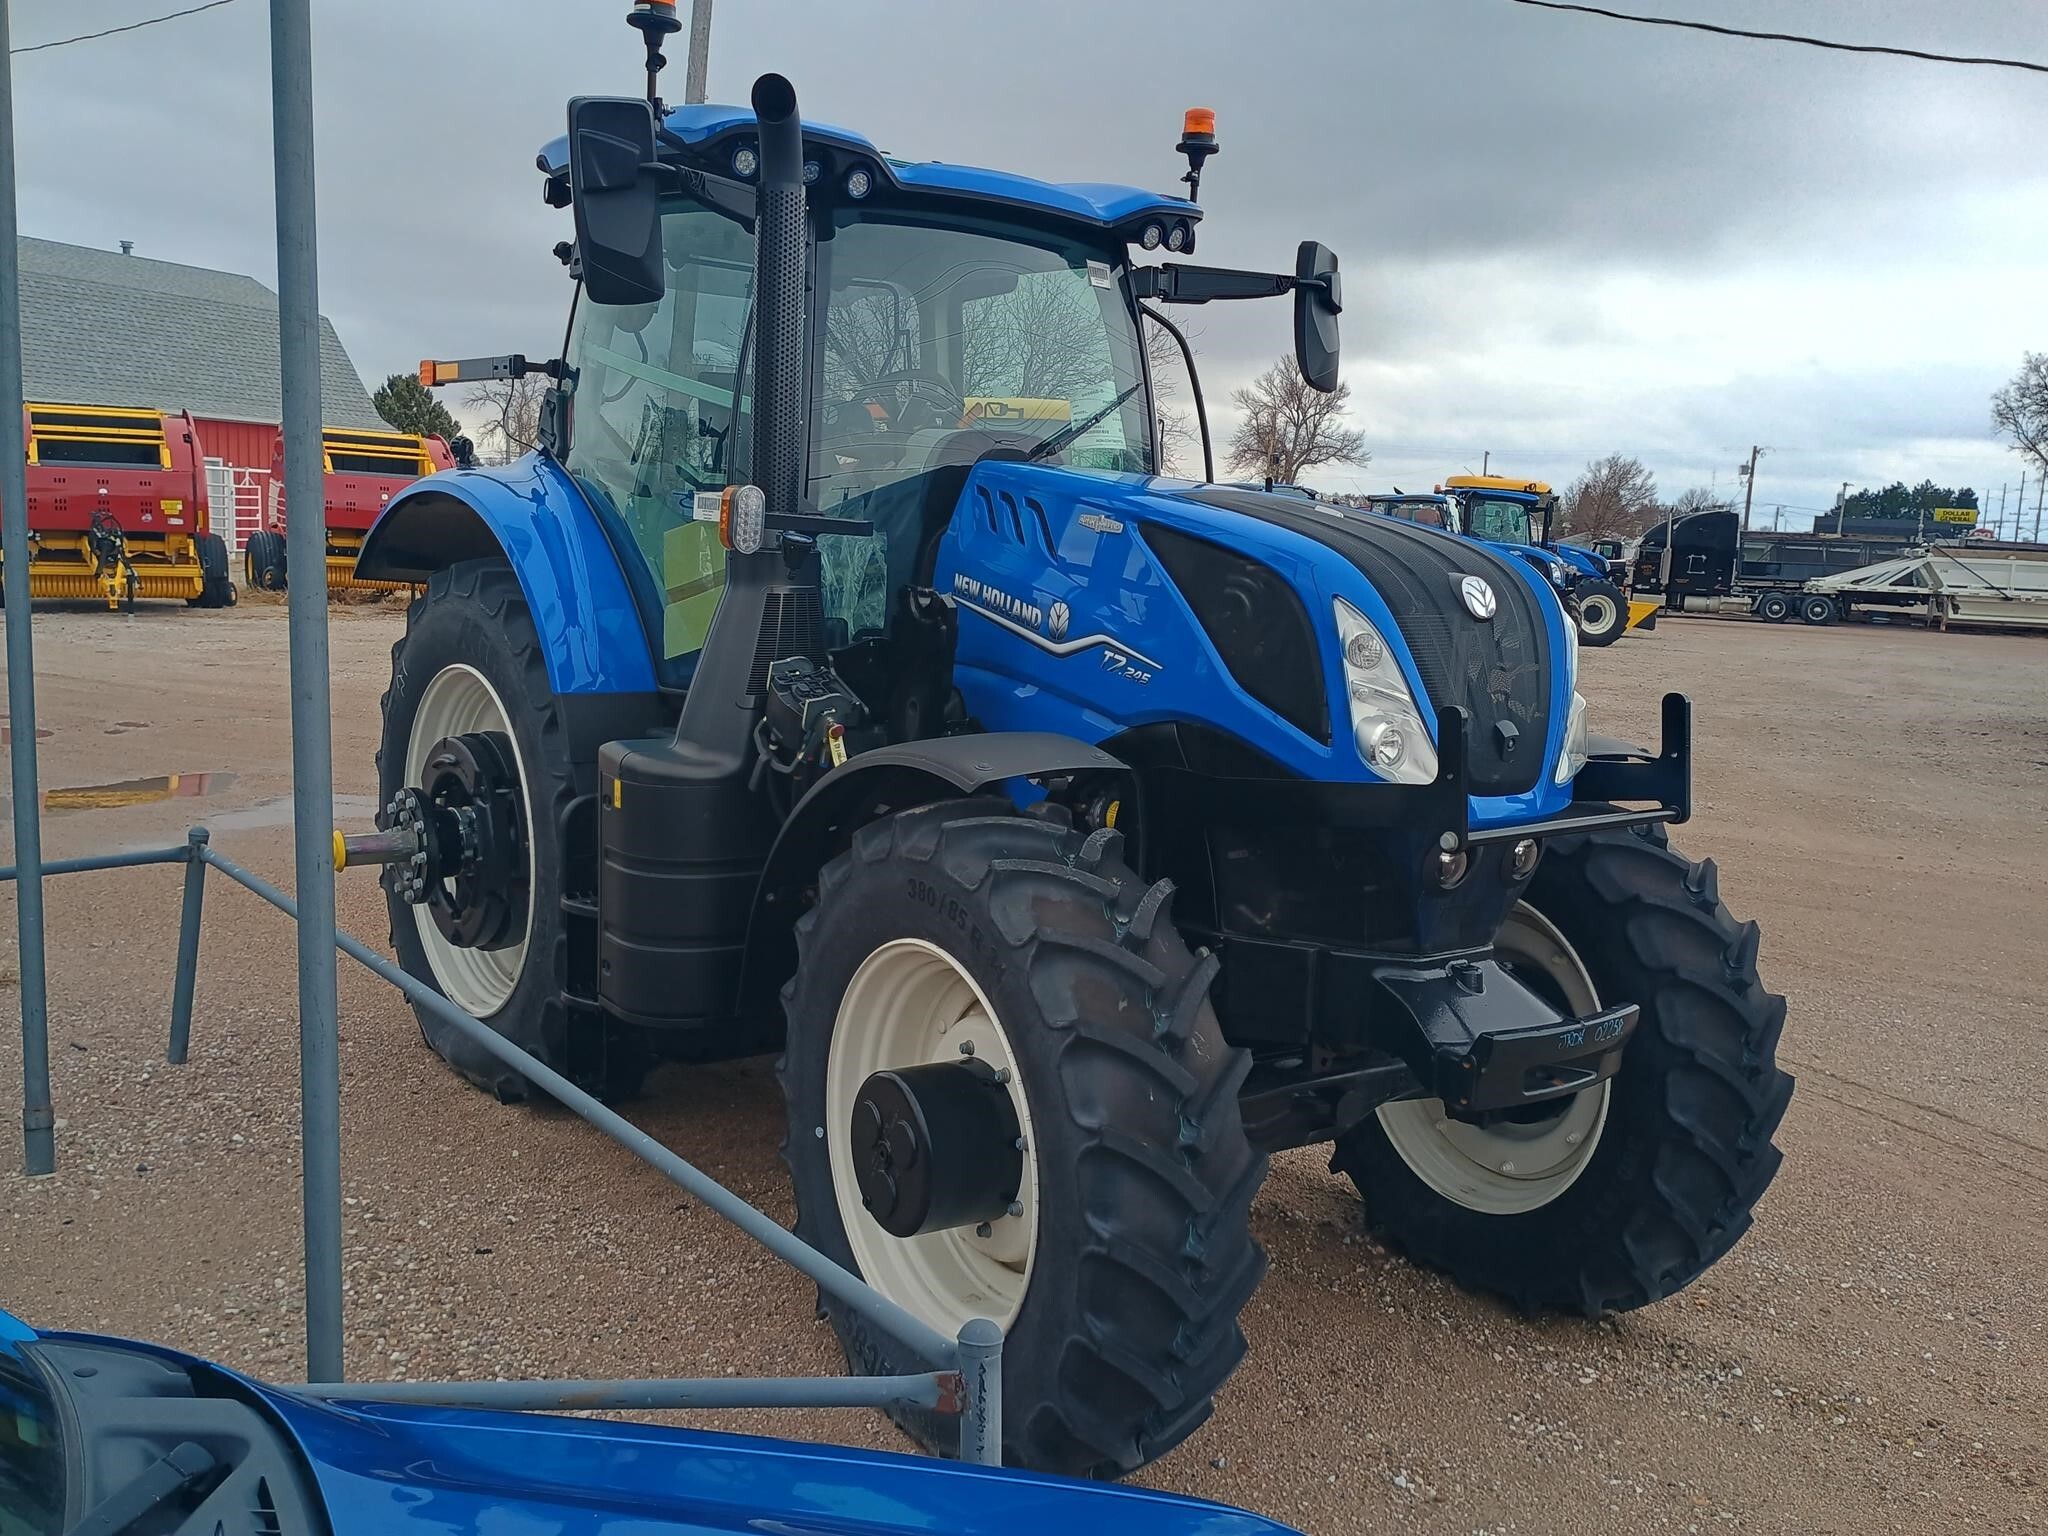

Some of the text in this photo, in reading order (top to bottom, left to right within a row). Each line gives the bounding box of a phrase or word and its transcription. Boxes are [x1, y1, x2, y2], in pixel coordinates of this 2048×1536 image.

[954, 573, 1043, 630] NEW HOLLAND
[1102, 650, 1152, 685] T7.245
[907, 878, 969, 931] 380/85
